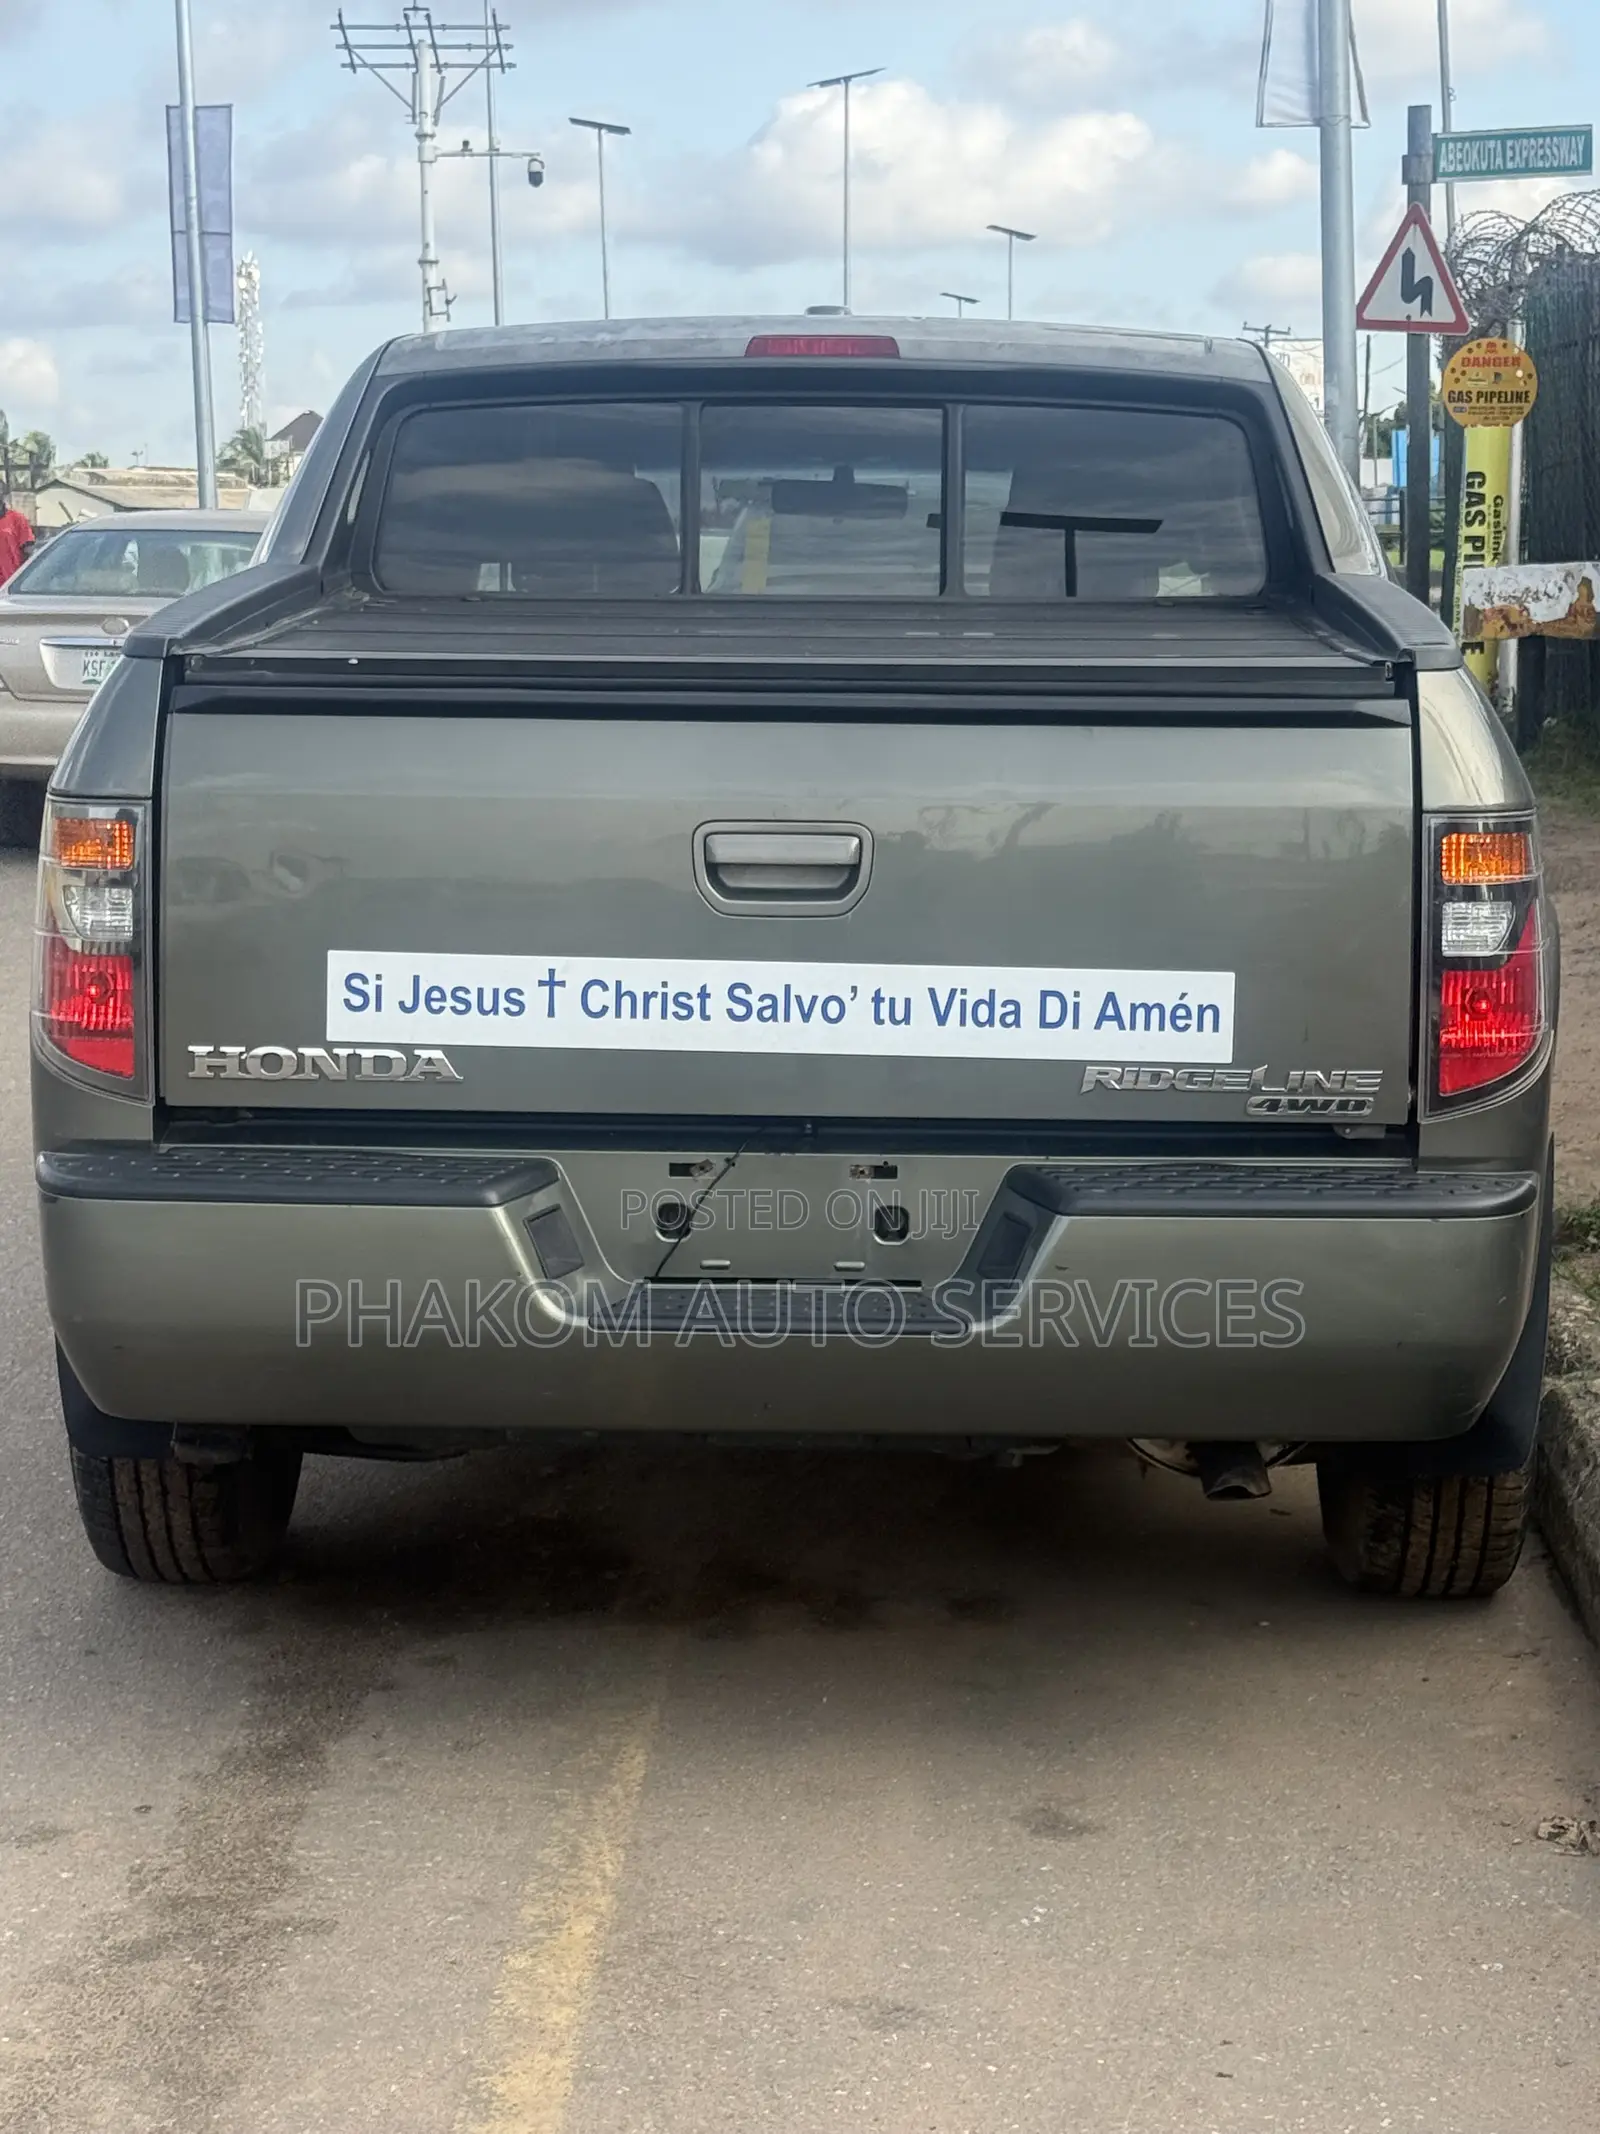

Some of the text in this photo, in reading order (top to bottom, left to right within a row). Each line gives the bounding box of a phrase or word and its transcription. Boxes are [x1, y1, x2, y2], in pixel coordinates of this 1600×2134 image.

[1439, 135, 1586, 172] ABEOKUTA EXPRESSWAY
[1461, 355, 1521, 368] DANGER
[1447, 390, 1531, 404] GAS PIPELINE
[1464, 471, 1486, 528] GAS
[1491, 495, 1504, 563] Gaslink
[343, 972, 383, 1013] Si
[398, 975, 526, 1017] Jesus
[580, 979, 712, 1022] Christ
[870, 987, 912, 1027] tu
[927, 987, 1022, 1029] Vida
[1039, 989, 1081, 1031] Di
[1093, 991, 1221, 1033] Amén
[188, 1045, 465, 1081] HONDA
[1080, 1064, 1384, 1095] RIDGELINE
[1246, 1096, 1375, 1116] 4WD
